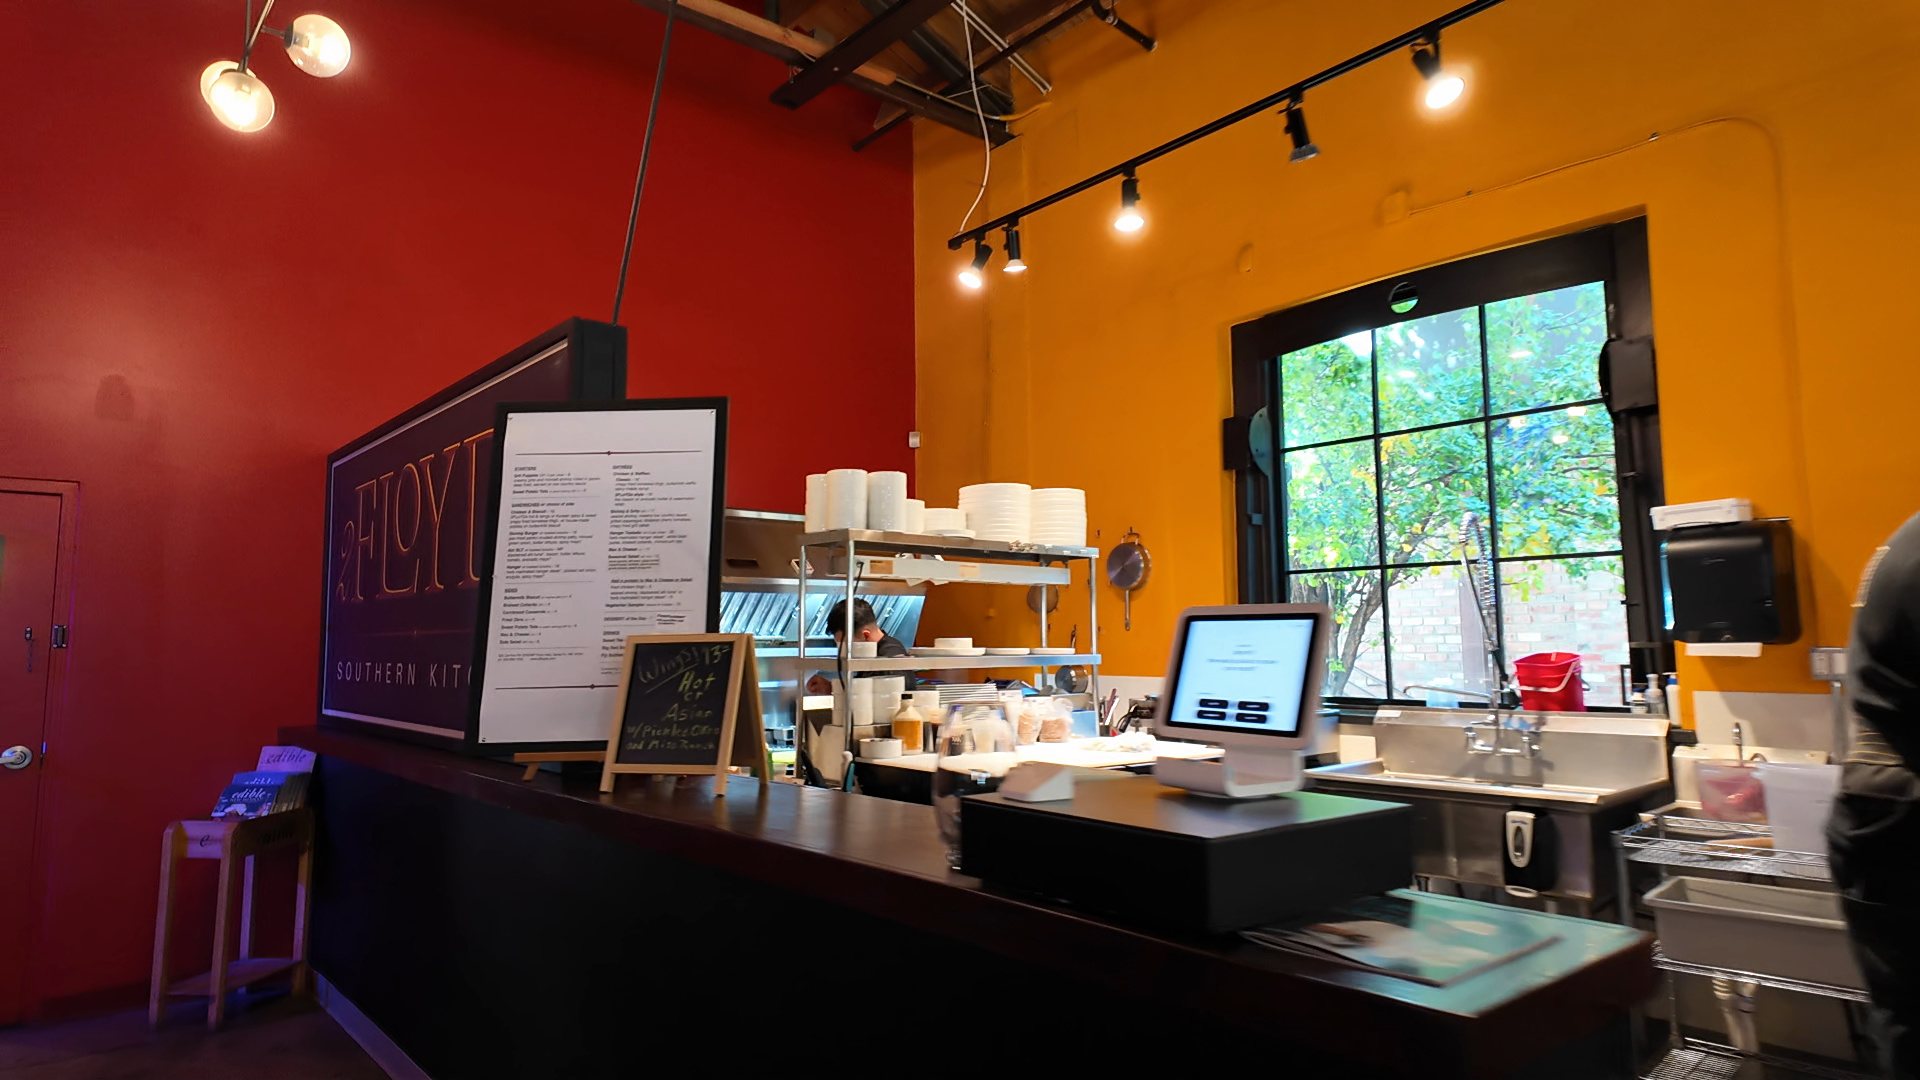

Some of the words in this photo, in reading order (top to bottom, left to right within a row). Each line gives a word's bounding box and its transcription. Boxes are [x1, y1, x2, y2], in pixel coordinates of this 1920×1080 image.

[336, 661, 416, 686] SOUTHERN
[677, 670, 717, 693] Hot
[683, 691, 704, 702] or
[660, 703, 714, 723] Asian
[266, 749, 307, 765] edible
[232, 788, 265, 800] edible
[200, 835, 210, 847] e
